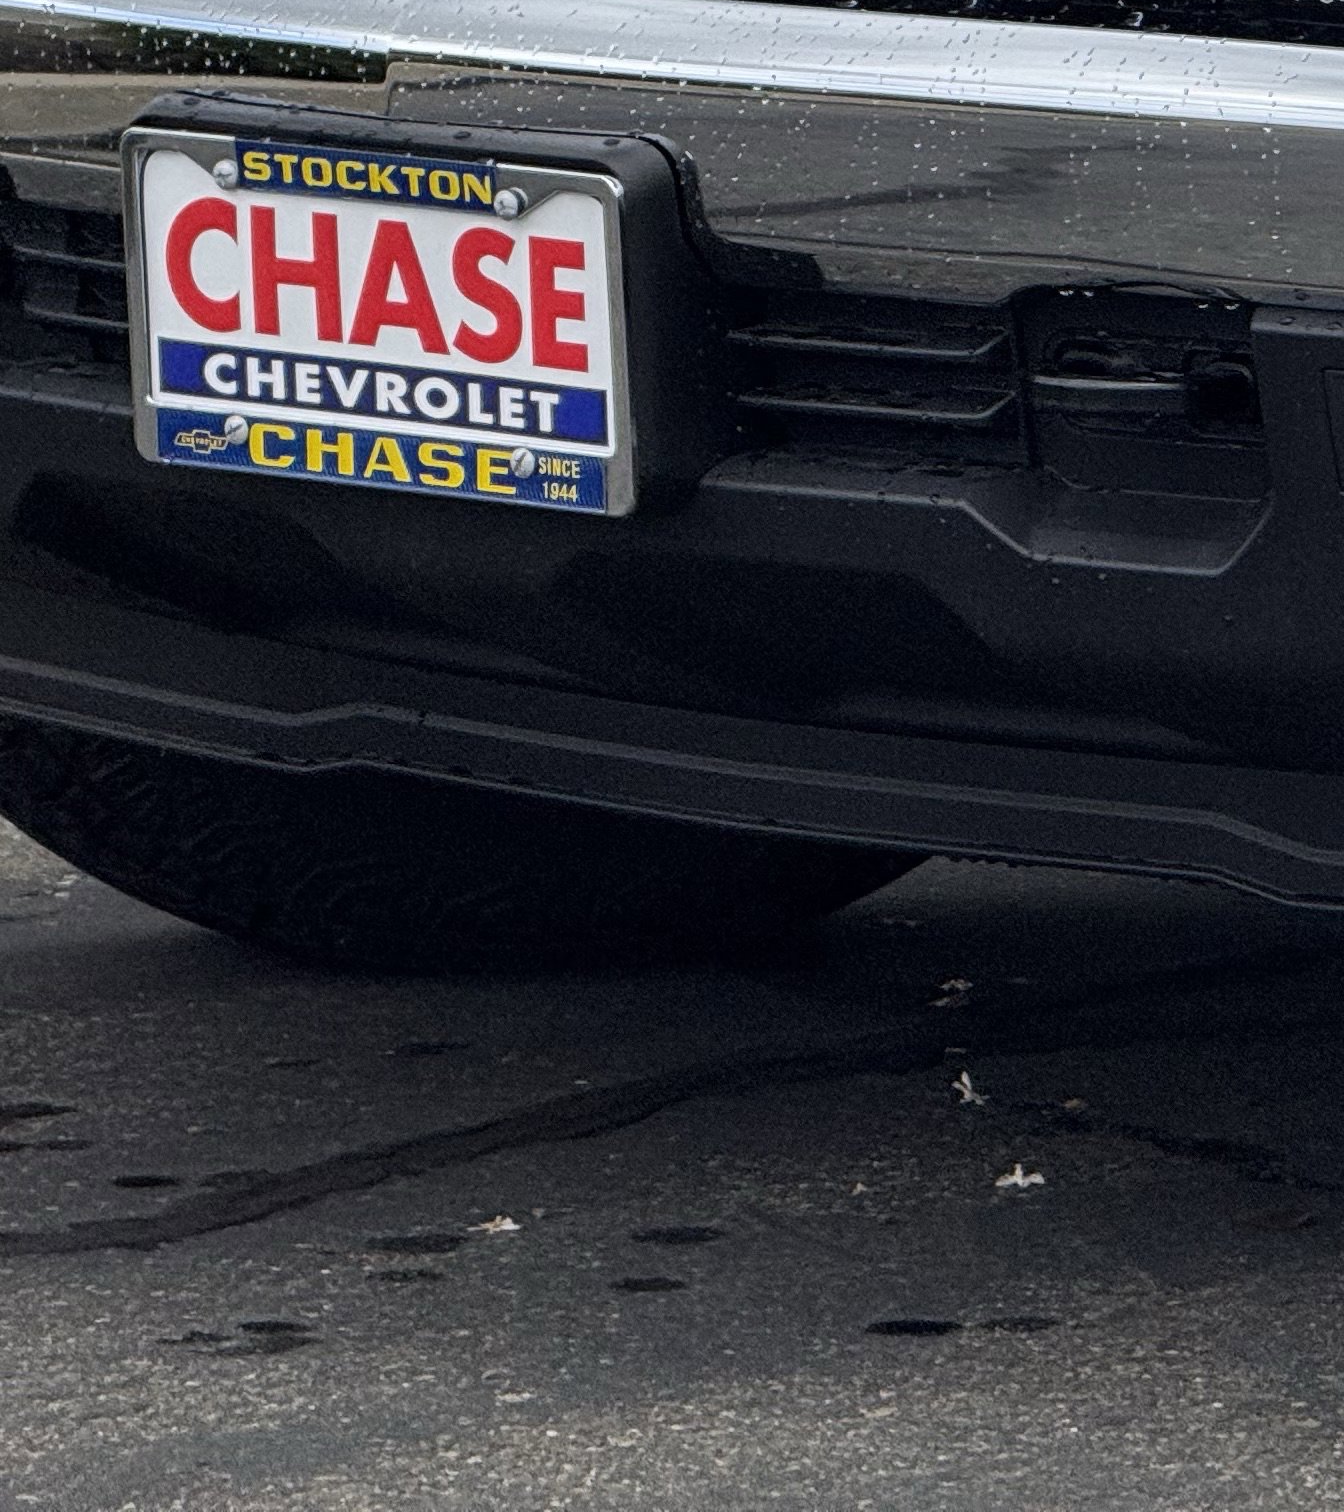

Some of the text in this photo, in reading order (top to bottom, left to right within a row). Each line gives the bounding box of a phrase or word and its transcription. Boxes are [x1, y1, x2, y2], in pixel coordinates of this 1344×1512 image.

[243, 152, 492, 205] STOCKTON
[166, 197, 589, 372] CHASE
[204, 354, 560, 433] CHEVROLET
[249, 423, 517, 495] CHASE
[538, 457, 581, 479] SINCE
[542, 482, 579, 503] 1944
